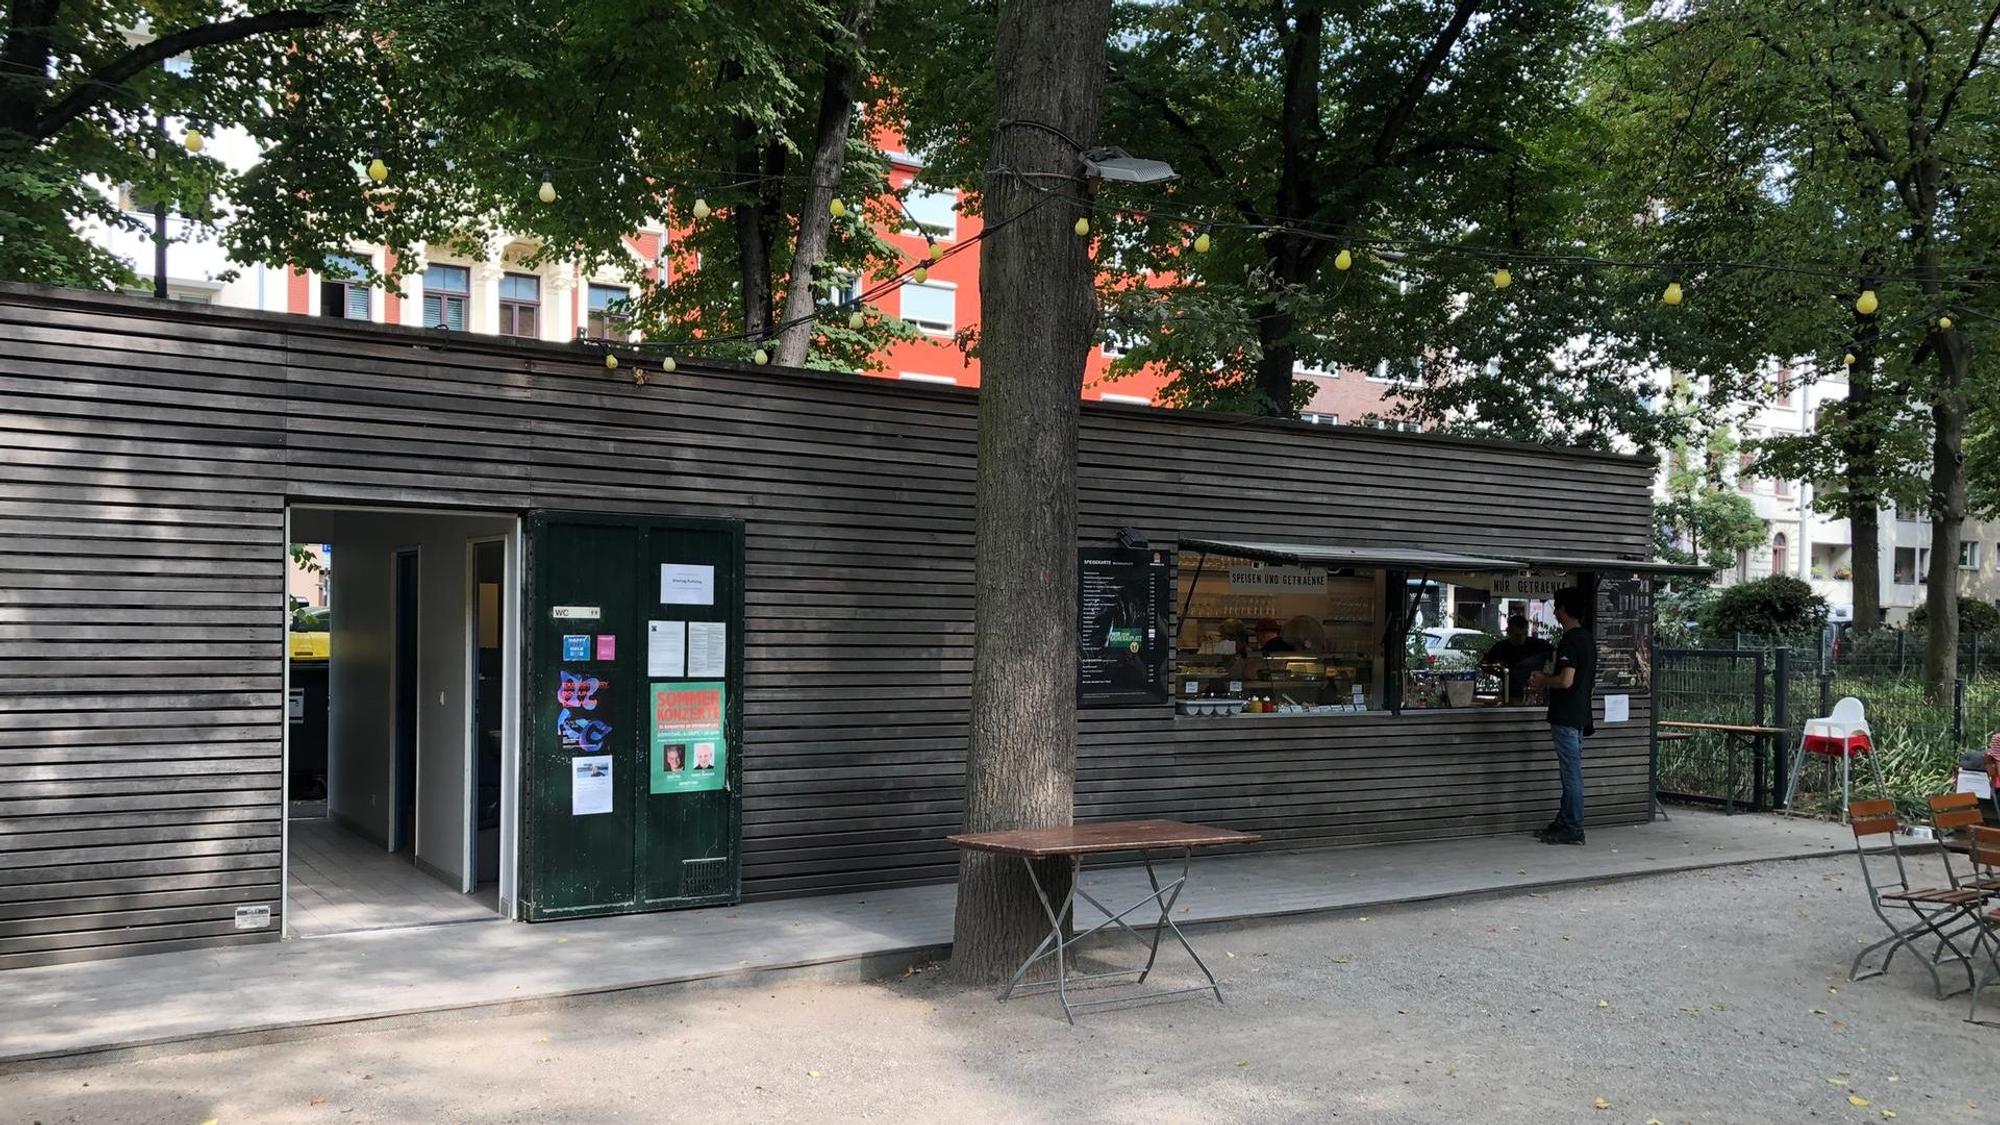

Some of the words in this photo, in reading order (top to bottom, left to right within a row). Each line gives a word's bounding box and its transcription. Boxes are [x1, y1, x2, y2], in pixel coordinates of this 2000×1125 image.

[1232, 572, 1261, 584] SPEISEN
[1264, 574, 1279, 585] UND
[1282, 575, 1325, 586] GETRAENKE
[1493, 579, 1510, 593] NUR
[555, 609, 569, 617] WC
[657, 690, 719, 705] SOMMER
[657, 705, 720, 721] KONZERTE
